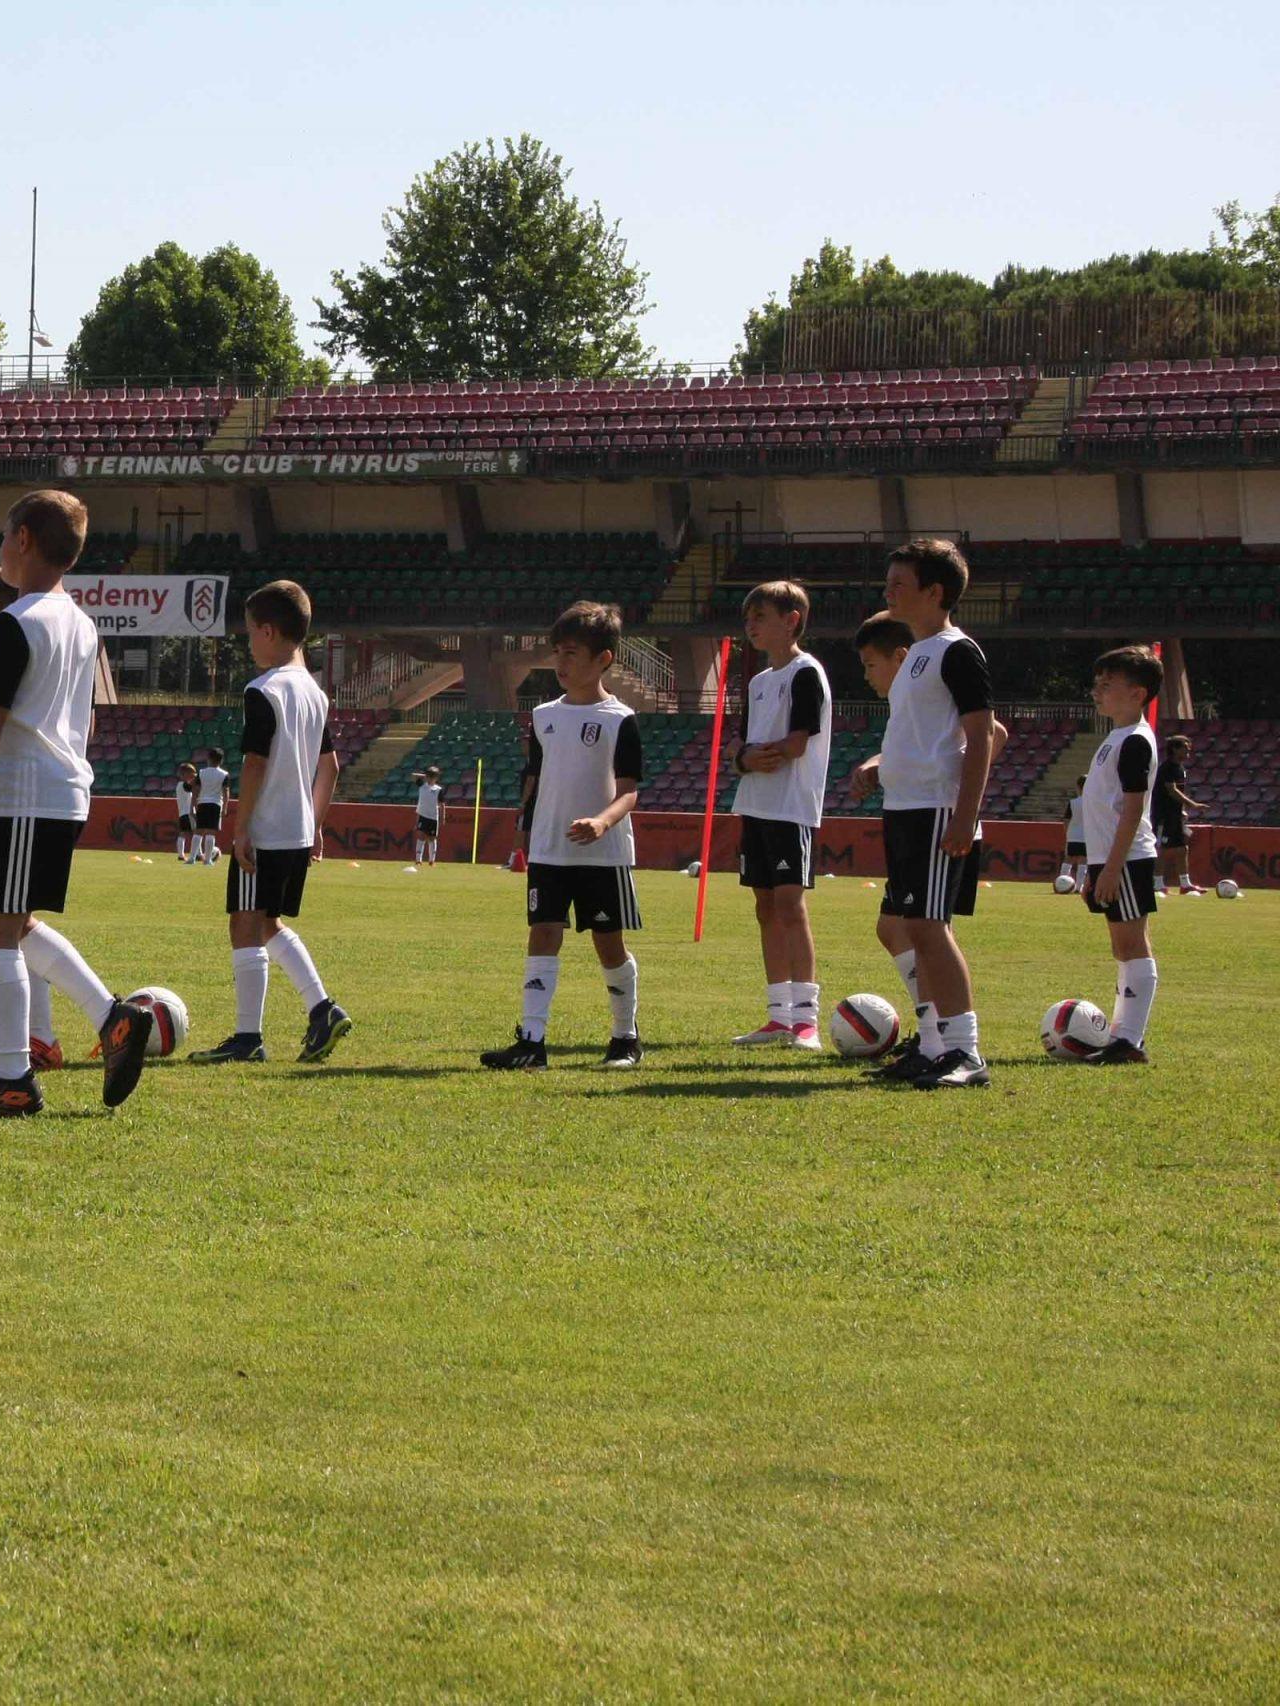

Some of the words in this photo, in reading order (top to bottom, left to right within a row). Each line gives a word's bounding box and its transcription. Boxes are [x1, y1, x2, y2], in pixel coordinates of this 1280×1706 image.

[83, 455, 205, 475] TERNANA
[223, 455, 293, 475] CLUB
[312, 453, 420, 474] THYRUS
[64, 579, 170, 615] ademy
